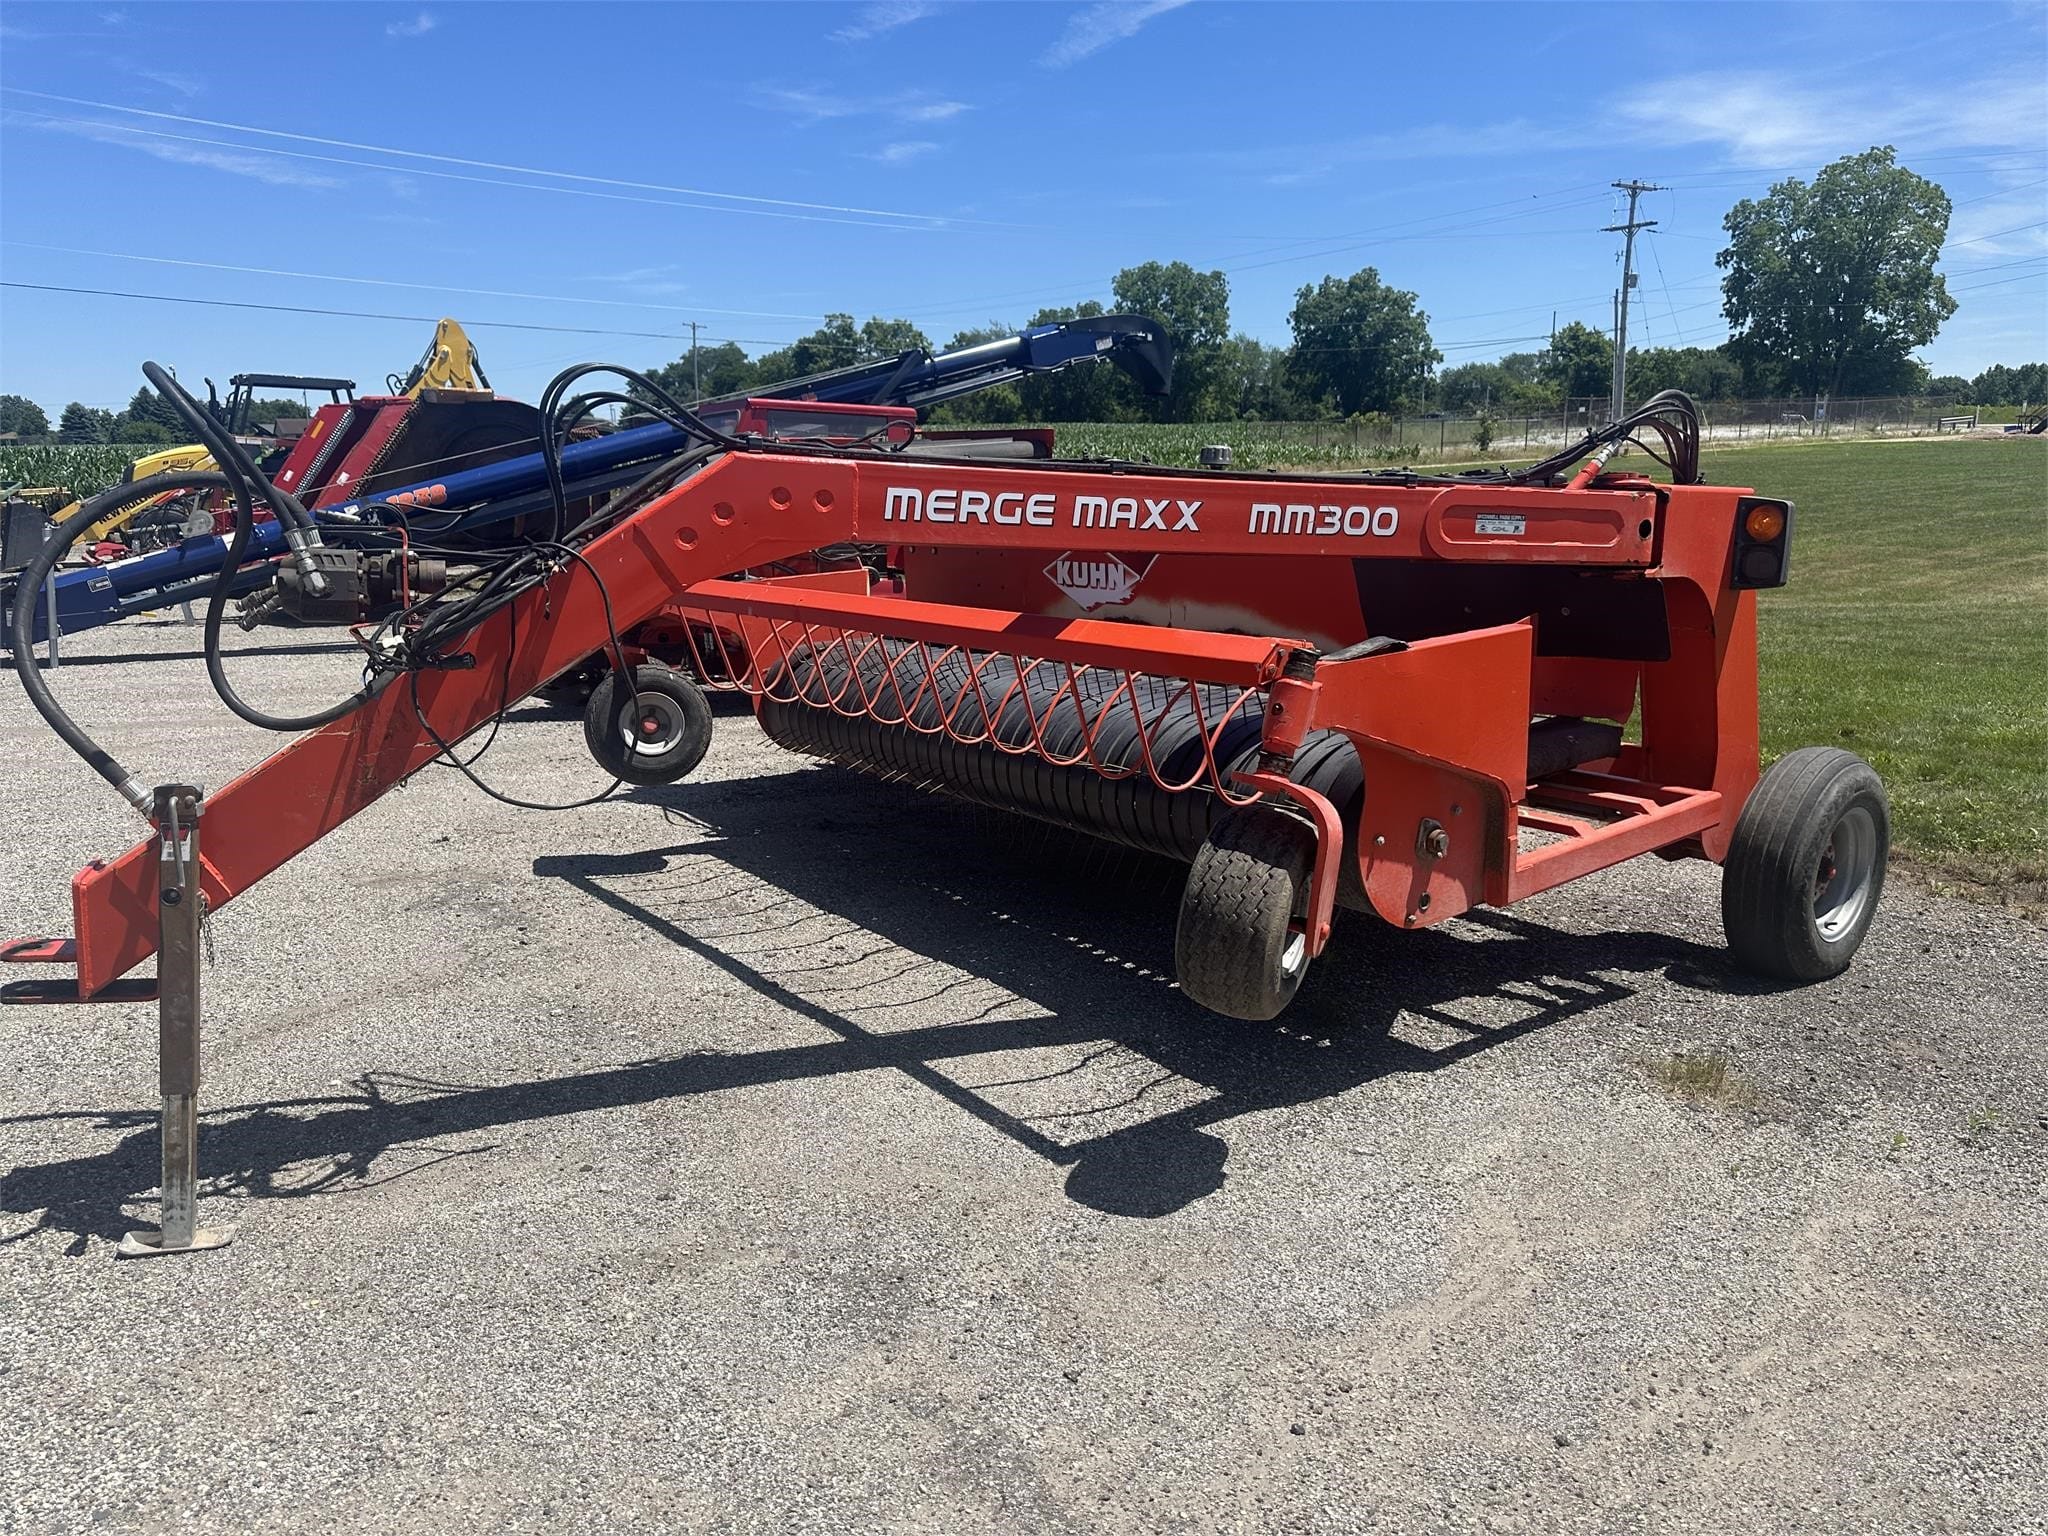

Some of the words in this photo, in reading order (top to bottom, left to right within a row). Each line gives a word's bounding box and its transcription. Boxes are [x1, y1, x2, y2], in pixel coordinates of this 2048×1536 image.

[98, 507, 120, 524] NEW
[884, 487, 1056, 526] MERGE
[1071, 495, 1202, 532] MAXX
[1247, 503, 1399, 536] MM300
[1056, 560, 1127, 590] KUHN
